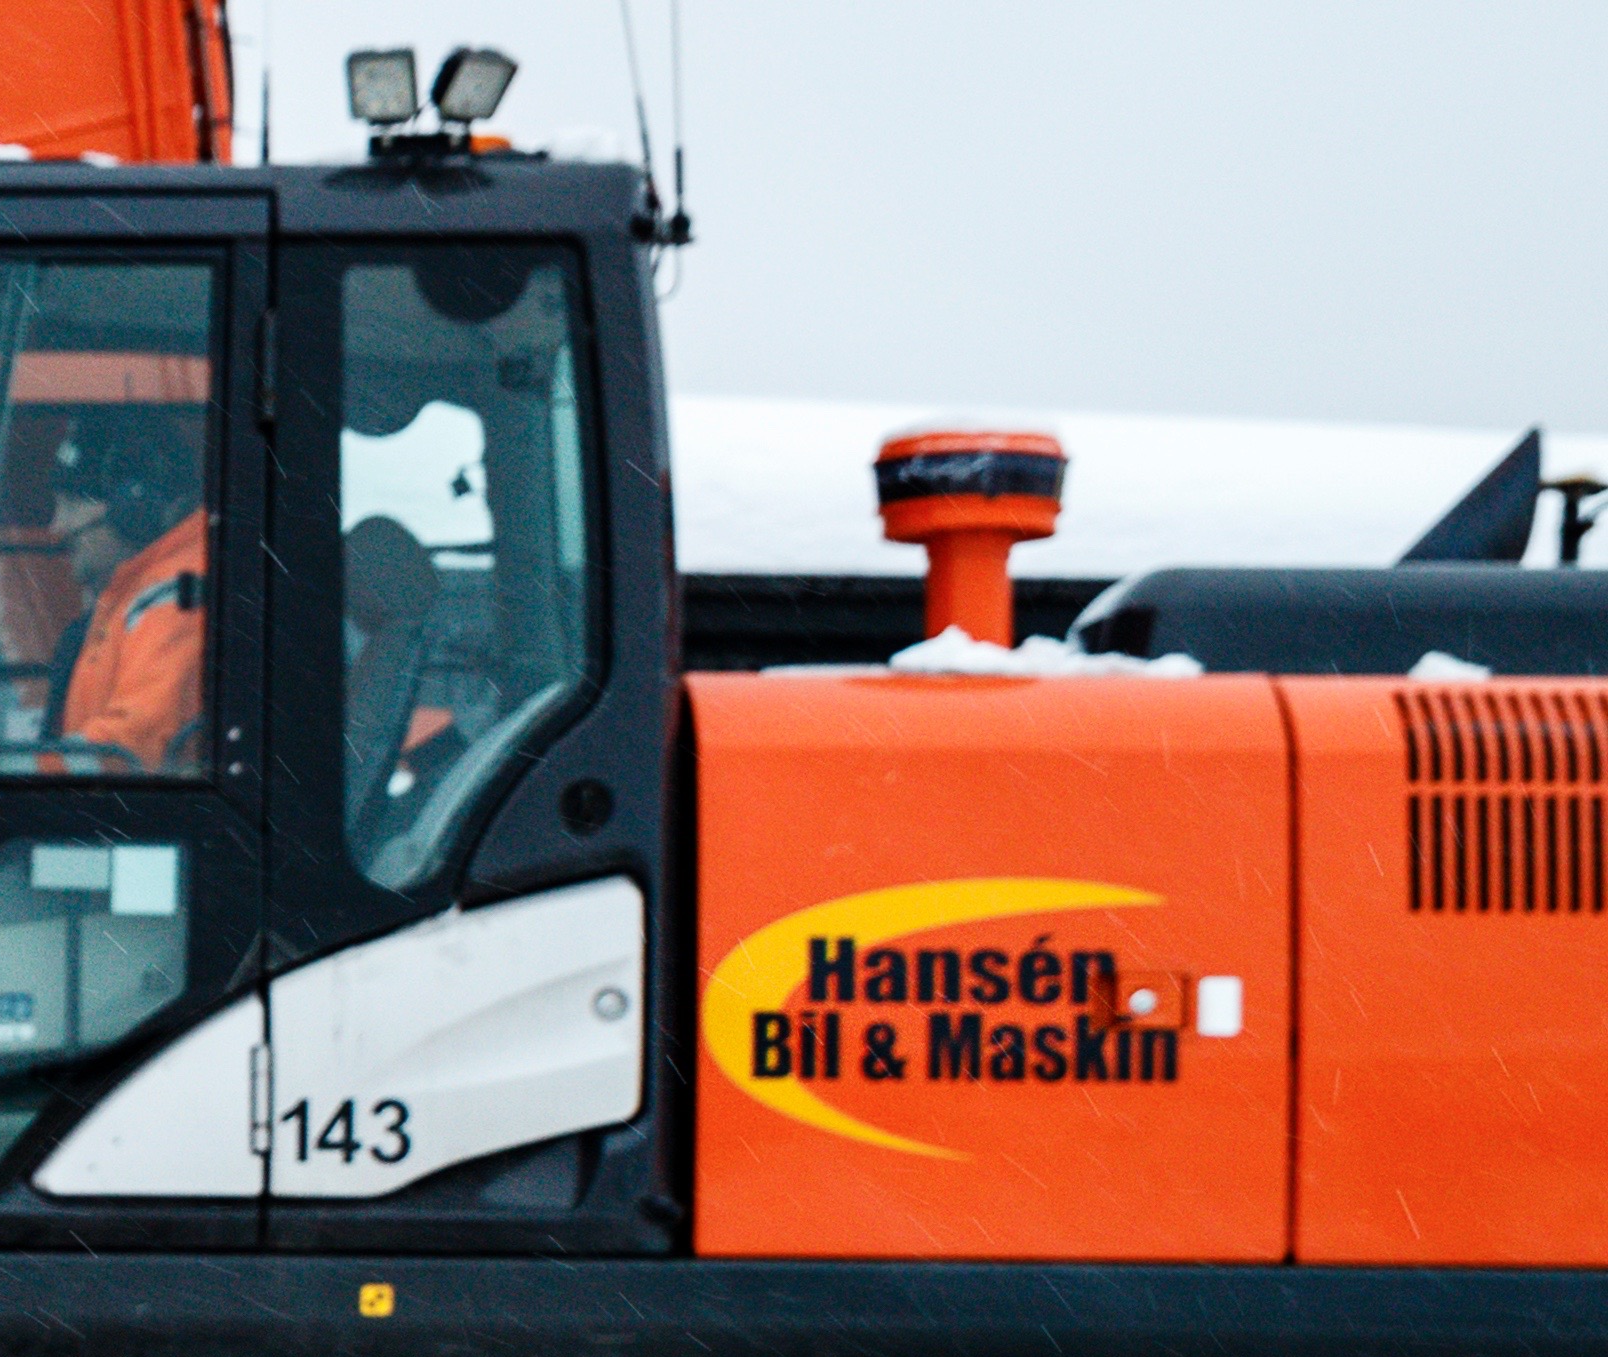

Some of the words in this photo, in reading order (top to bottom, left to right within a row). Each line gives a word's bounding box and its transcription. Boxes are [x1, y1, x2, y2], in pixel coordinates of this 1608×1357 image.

[807, 934, 1116, 1004] Hansén
[750, 1010, 841, 1080] Bil
[861, 1019, 907, 1080] &
[927, 1012, 1179, 1082] Maskin
[280, 1098, 411, 1164] 143
